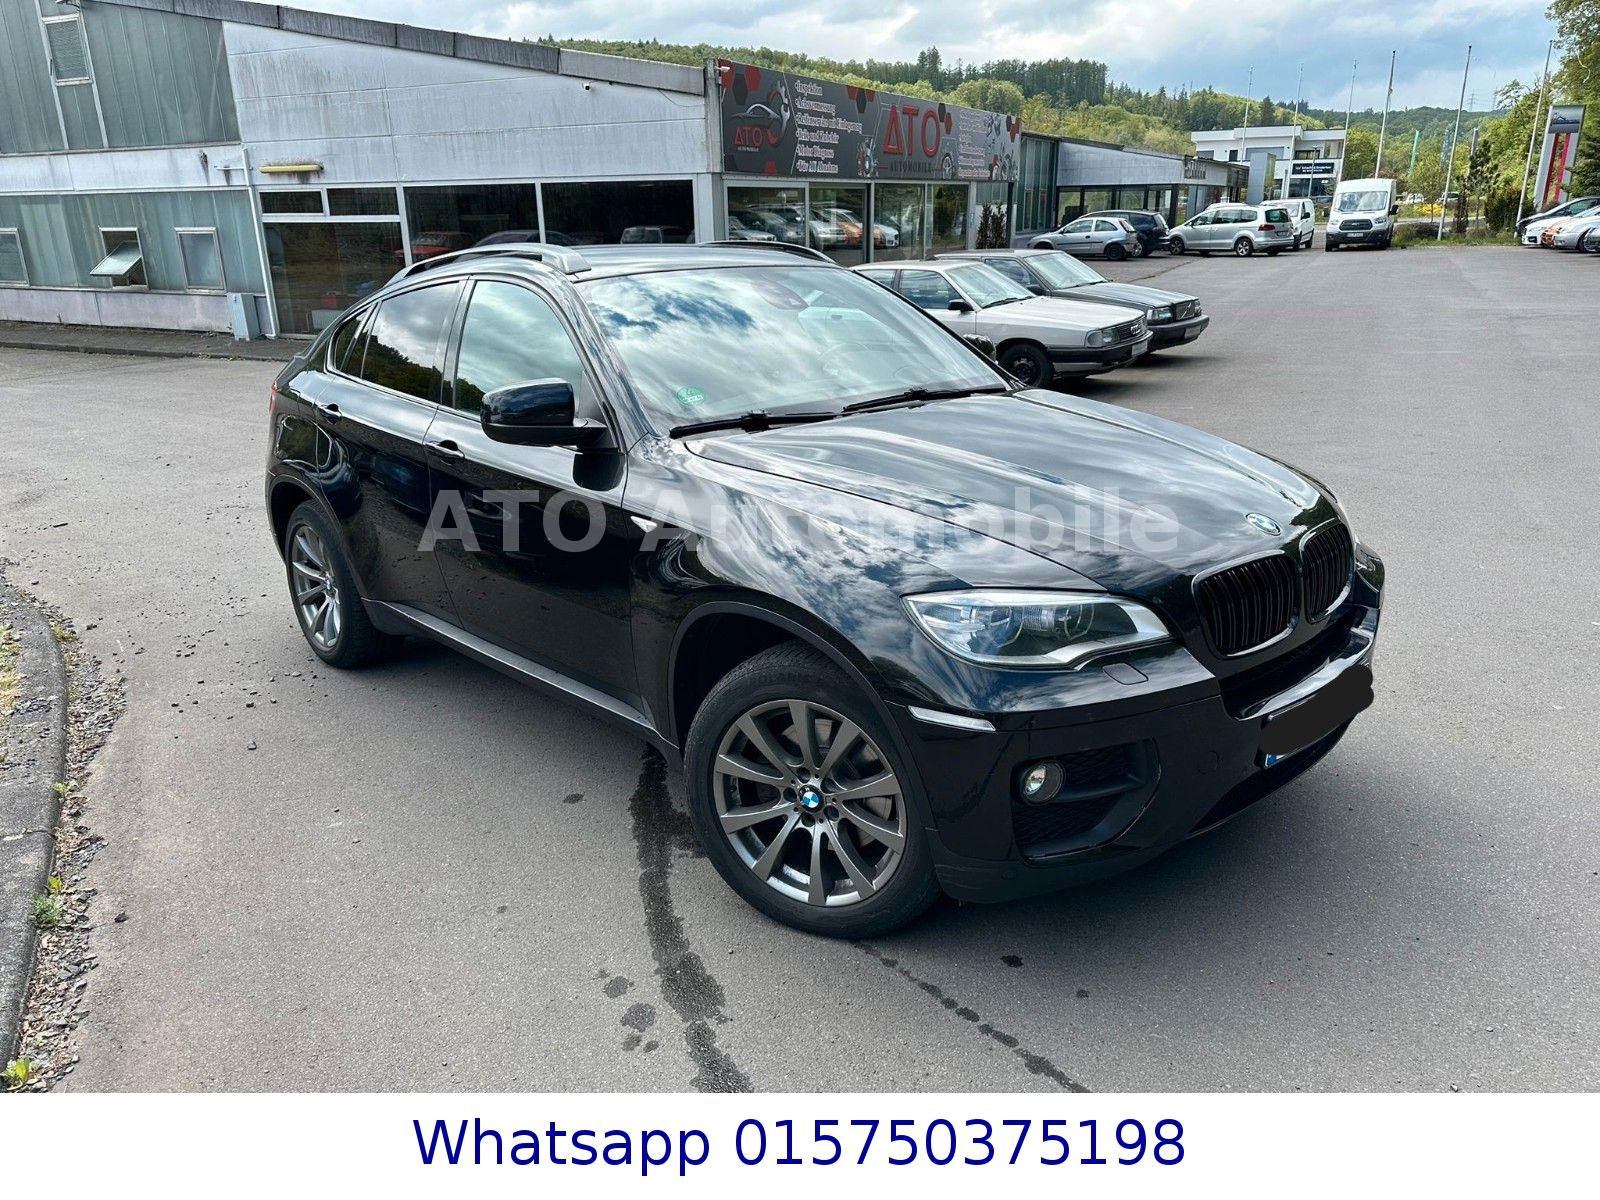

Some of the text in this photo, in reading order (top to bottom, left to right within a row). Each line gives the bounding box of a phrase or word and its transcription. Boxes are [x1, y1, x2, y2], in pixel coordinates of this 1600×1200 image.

[733, 125, 764, 148] ATO
[883, 104, 941, 157] ATO
[889, 160, 932, 173] AUTOMOBILE
